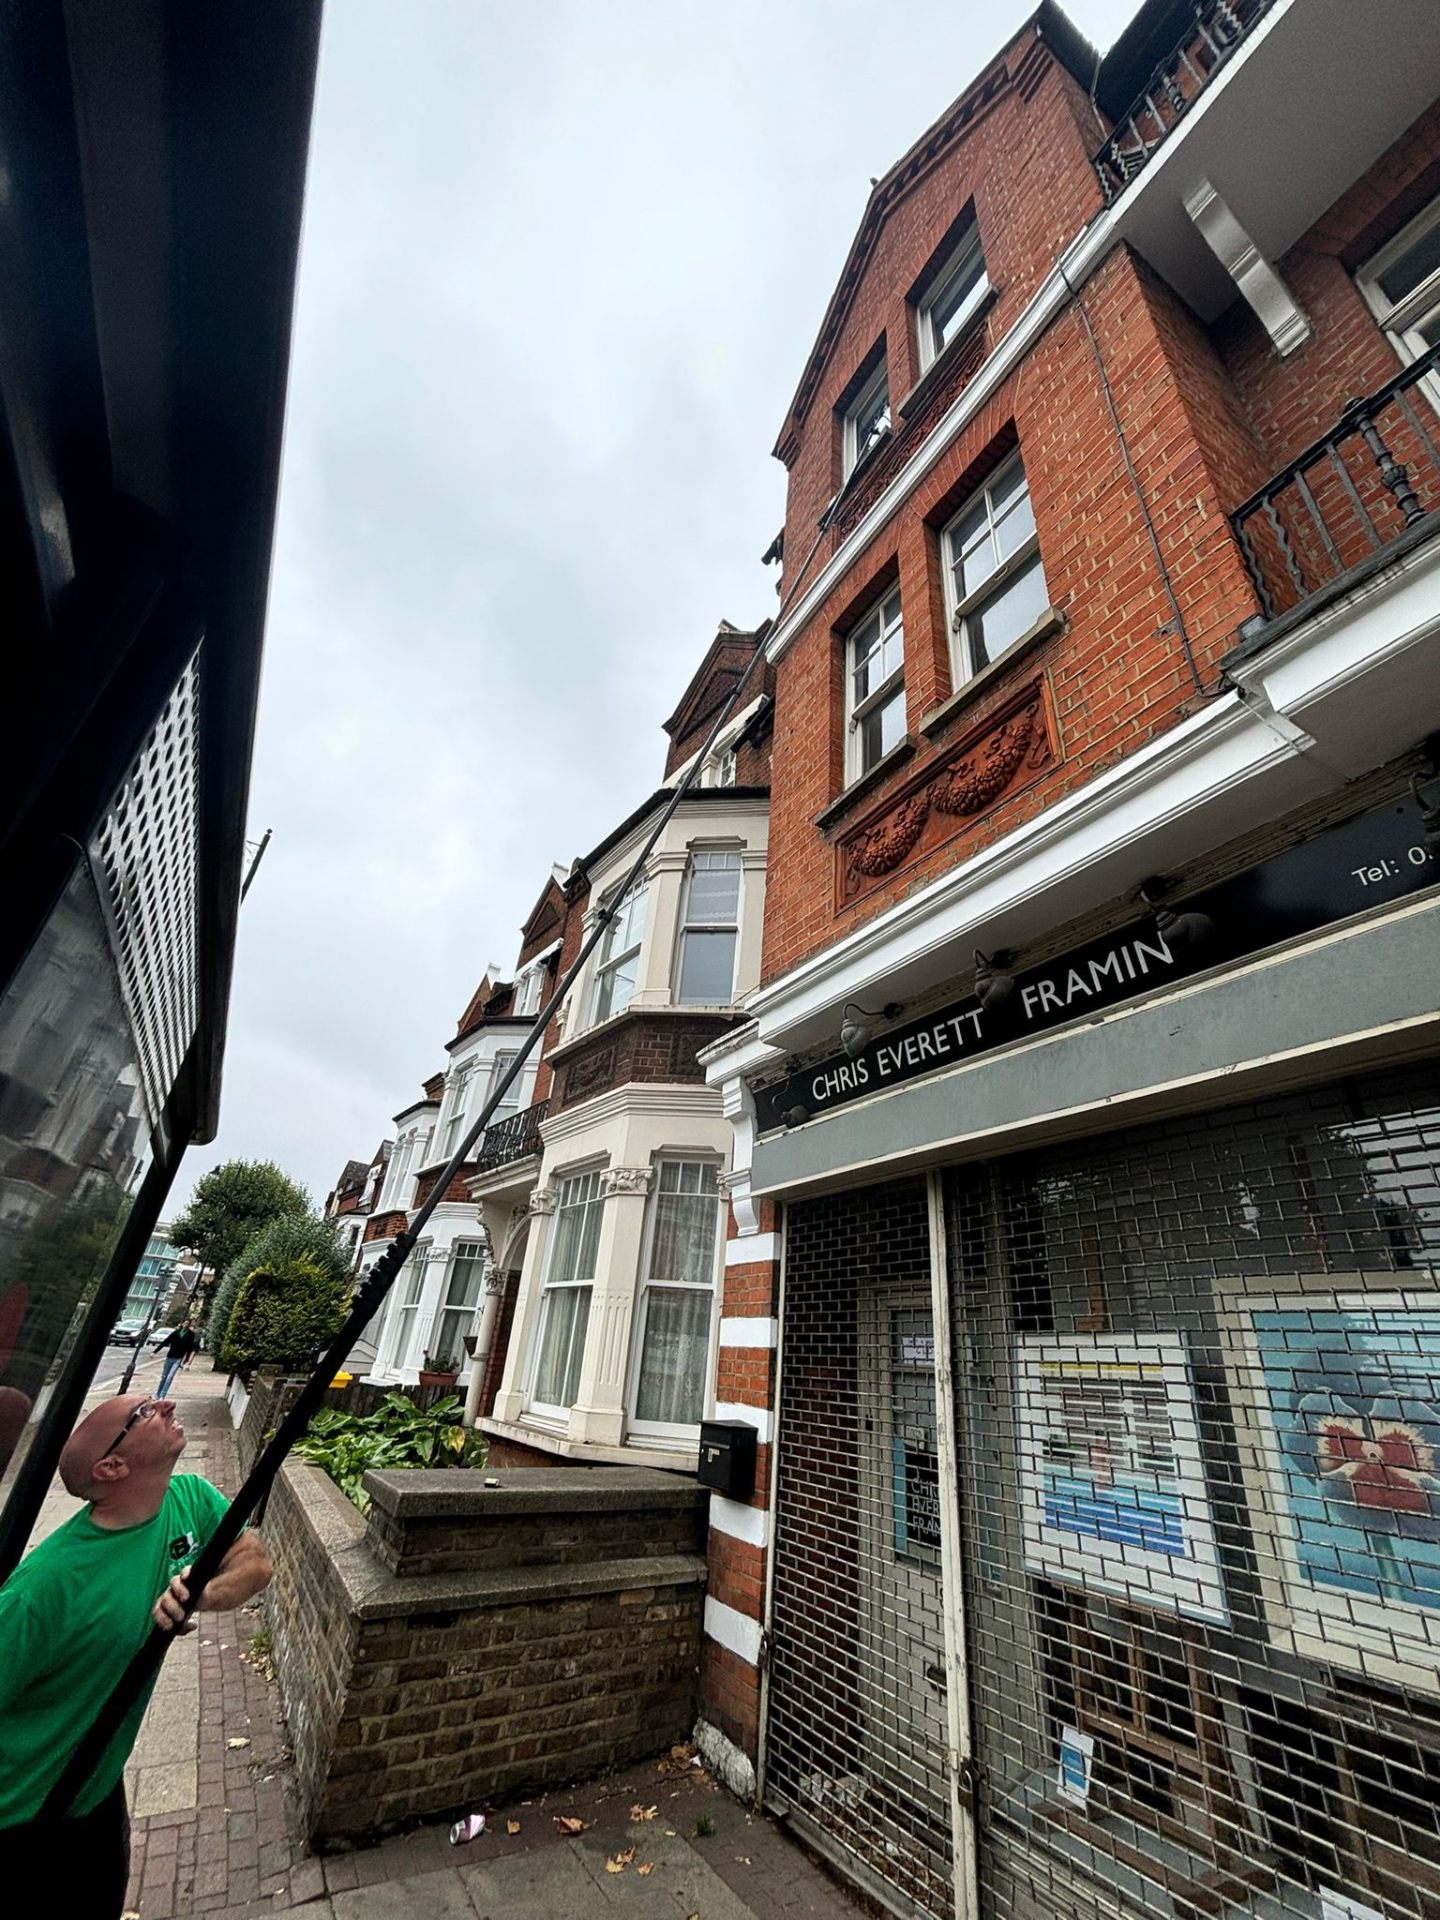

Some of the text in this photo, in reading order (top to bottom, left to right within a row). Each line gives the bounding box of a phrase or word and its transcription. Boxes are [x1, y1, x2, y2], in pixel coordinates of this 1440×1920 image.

[1351, 846, 1434, 886] Tel: 0
[812, 931, 1174, 1100] CHRIS EVERETT FRAMIN
